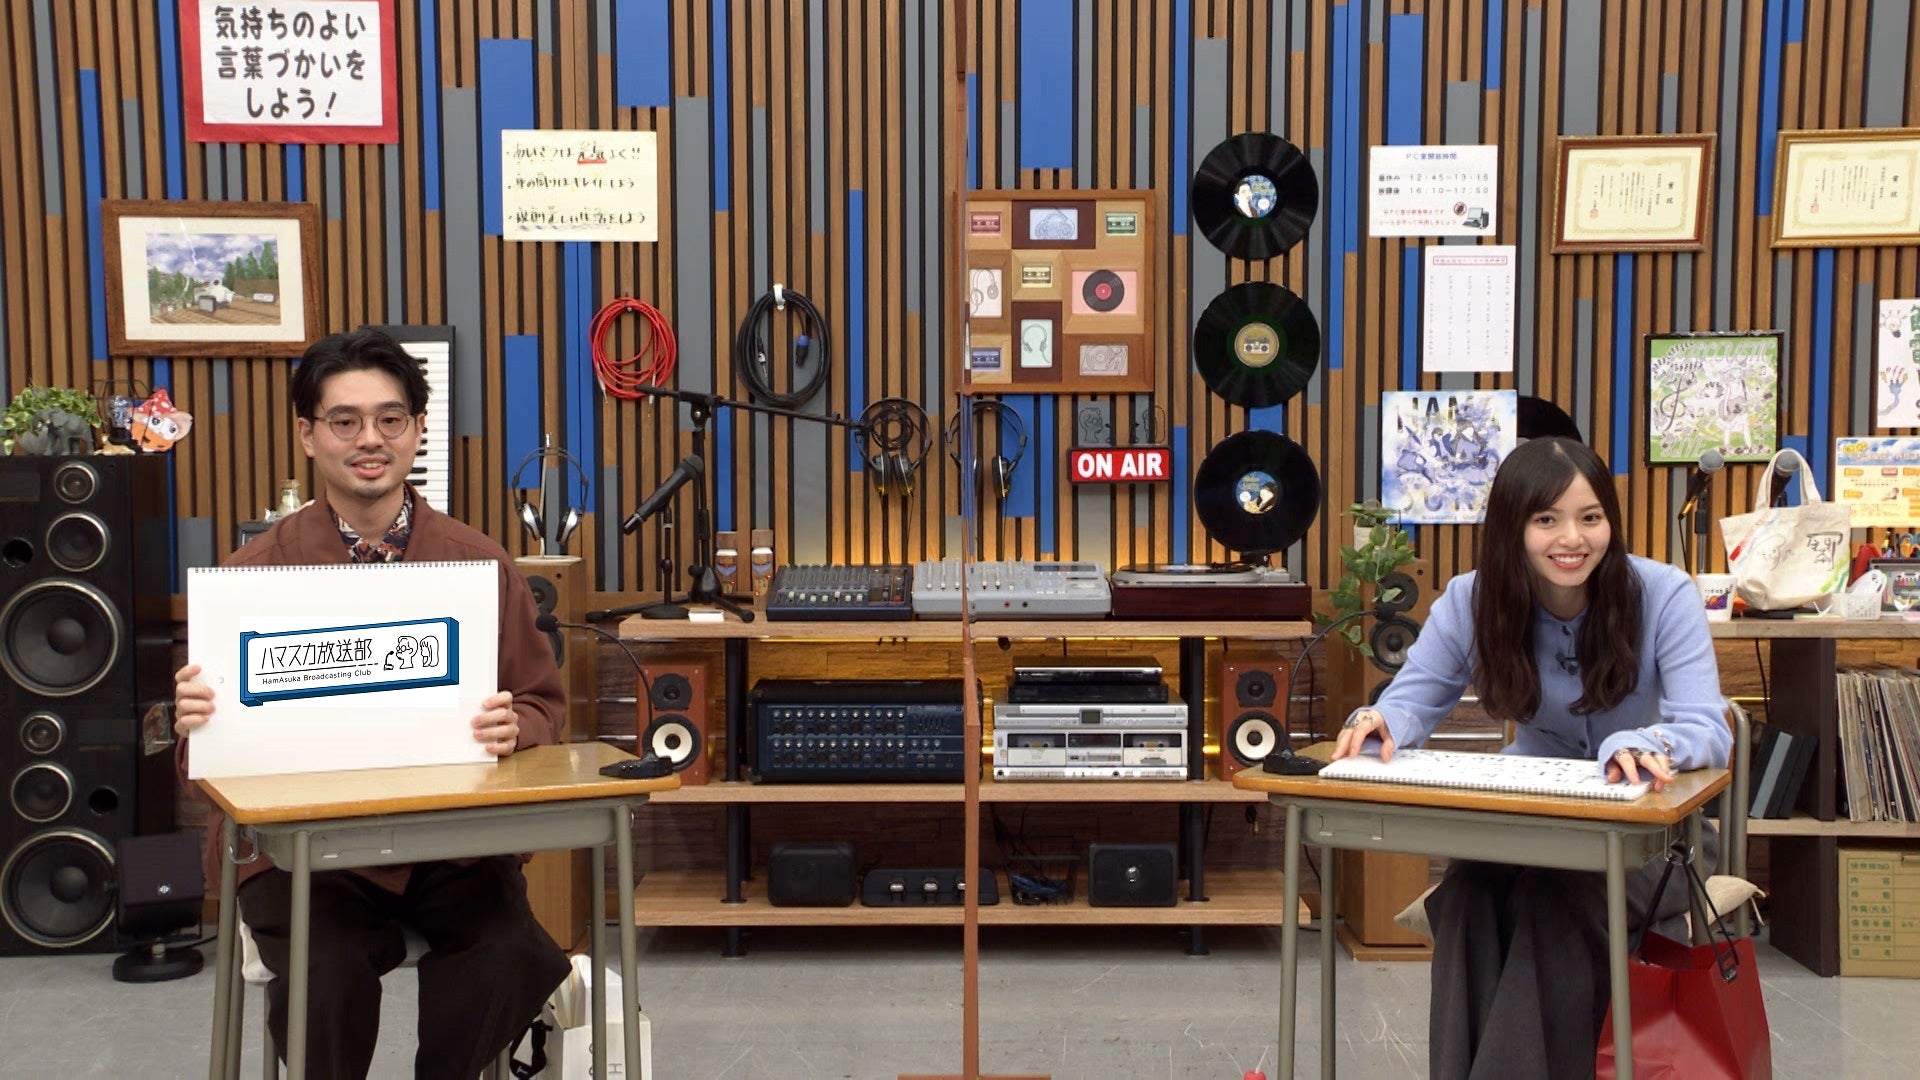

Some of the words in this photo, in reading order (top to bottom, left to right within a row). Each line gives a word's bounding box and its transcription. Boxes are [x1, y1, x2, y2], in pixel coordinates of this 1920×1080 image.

[215, 6, 366, 40] 気持ちのよい
[215, 46, 365, 80] 言葉づかいを
[247, 87, 337, 119] しよう！
[1077, 453, 1113, 478] ON
[1119, 453, 1163, 477] AIR
[262, 638, 373, 670] ハマスカ放送部
[262, 676, 301, 685] HamAsuka
[303, 671, 352, 682] Broadcasting
[354, 669, 372, 677] Club
